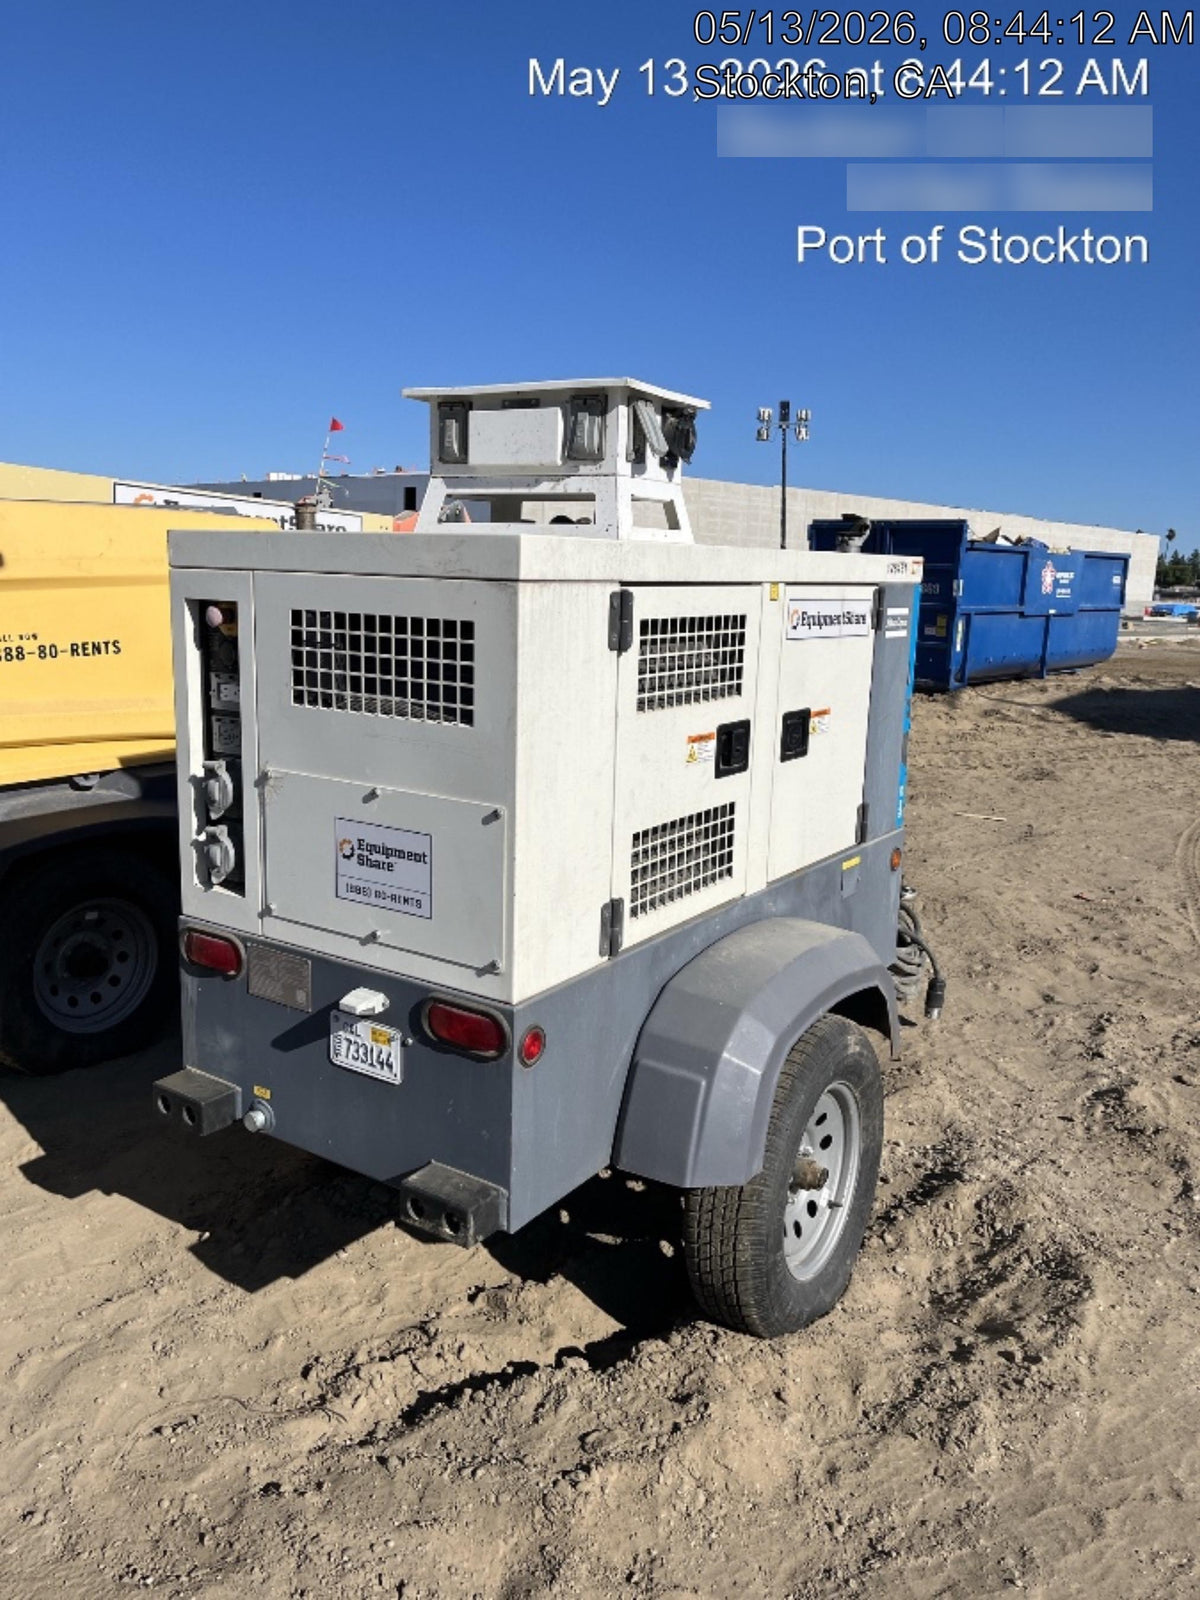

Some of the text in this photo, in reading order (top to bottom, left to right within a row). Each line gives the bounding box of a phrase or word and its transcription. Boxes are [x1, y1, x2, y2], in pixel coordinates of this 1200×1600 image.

[357, 839, 428, 864] Equipment
[357, 853, 394, 872] Share
[343, 1036, 394, 1073] 733144
